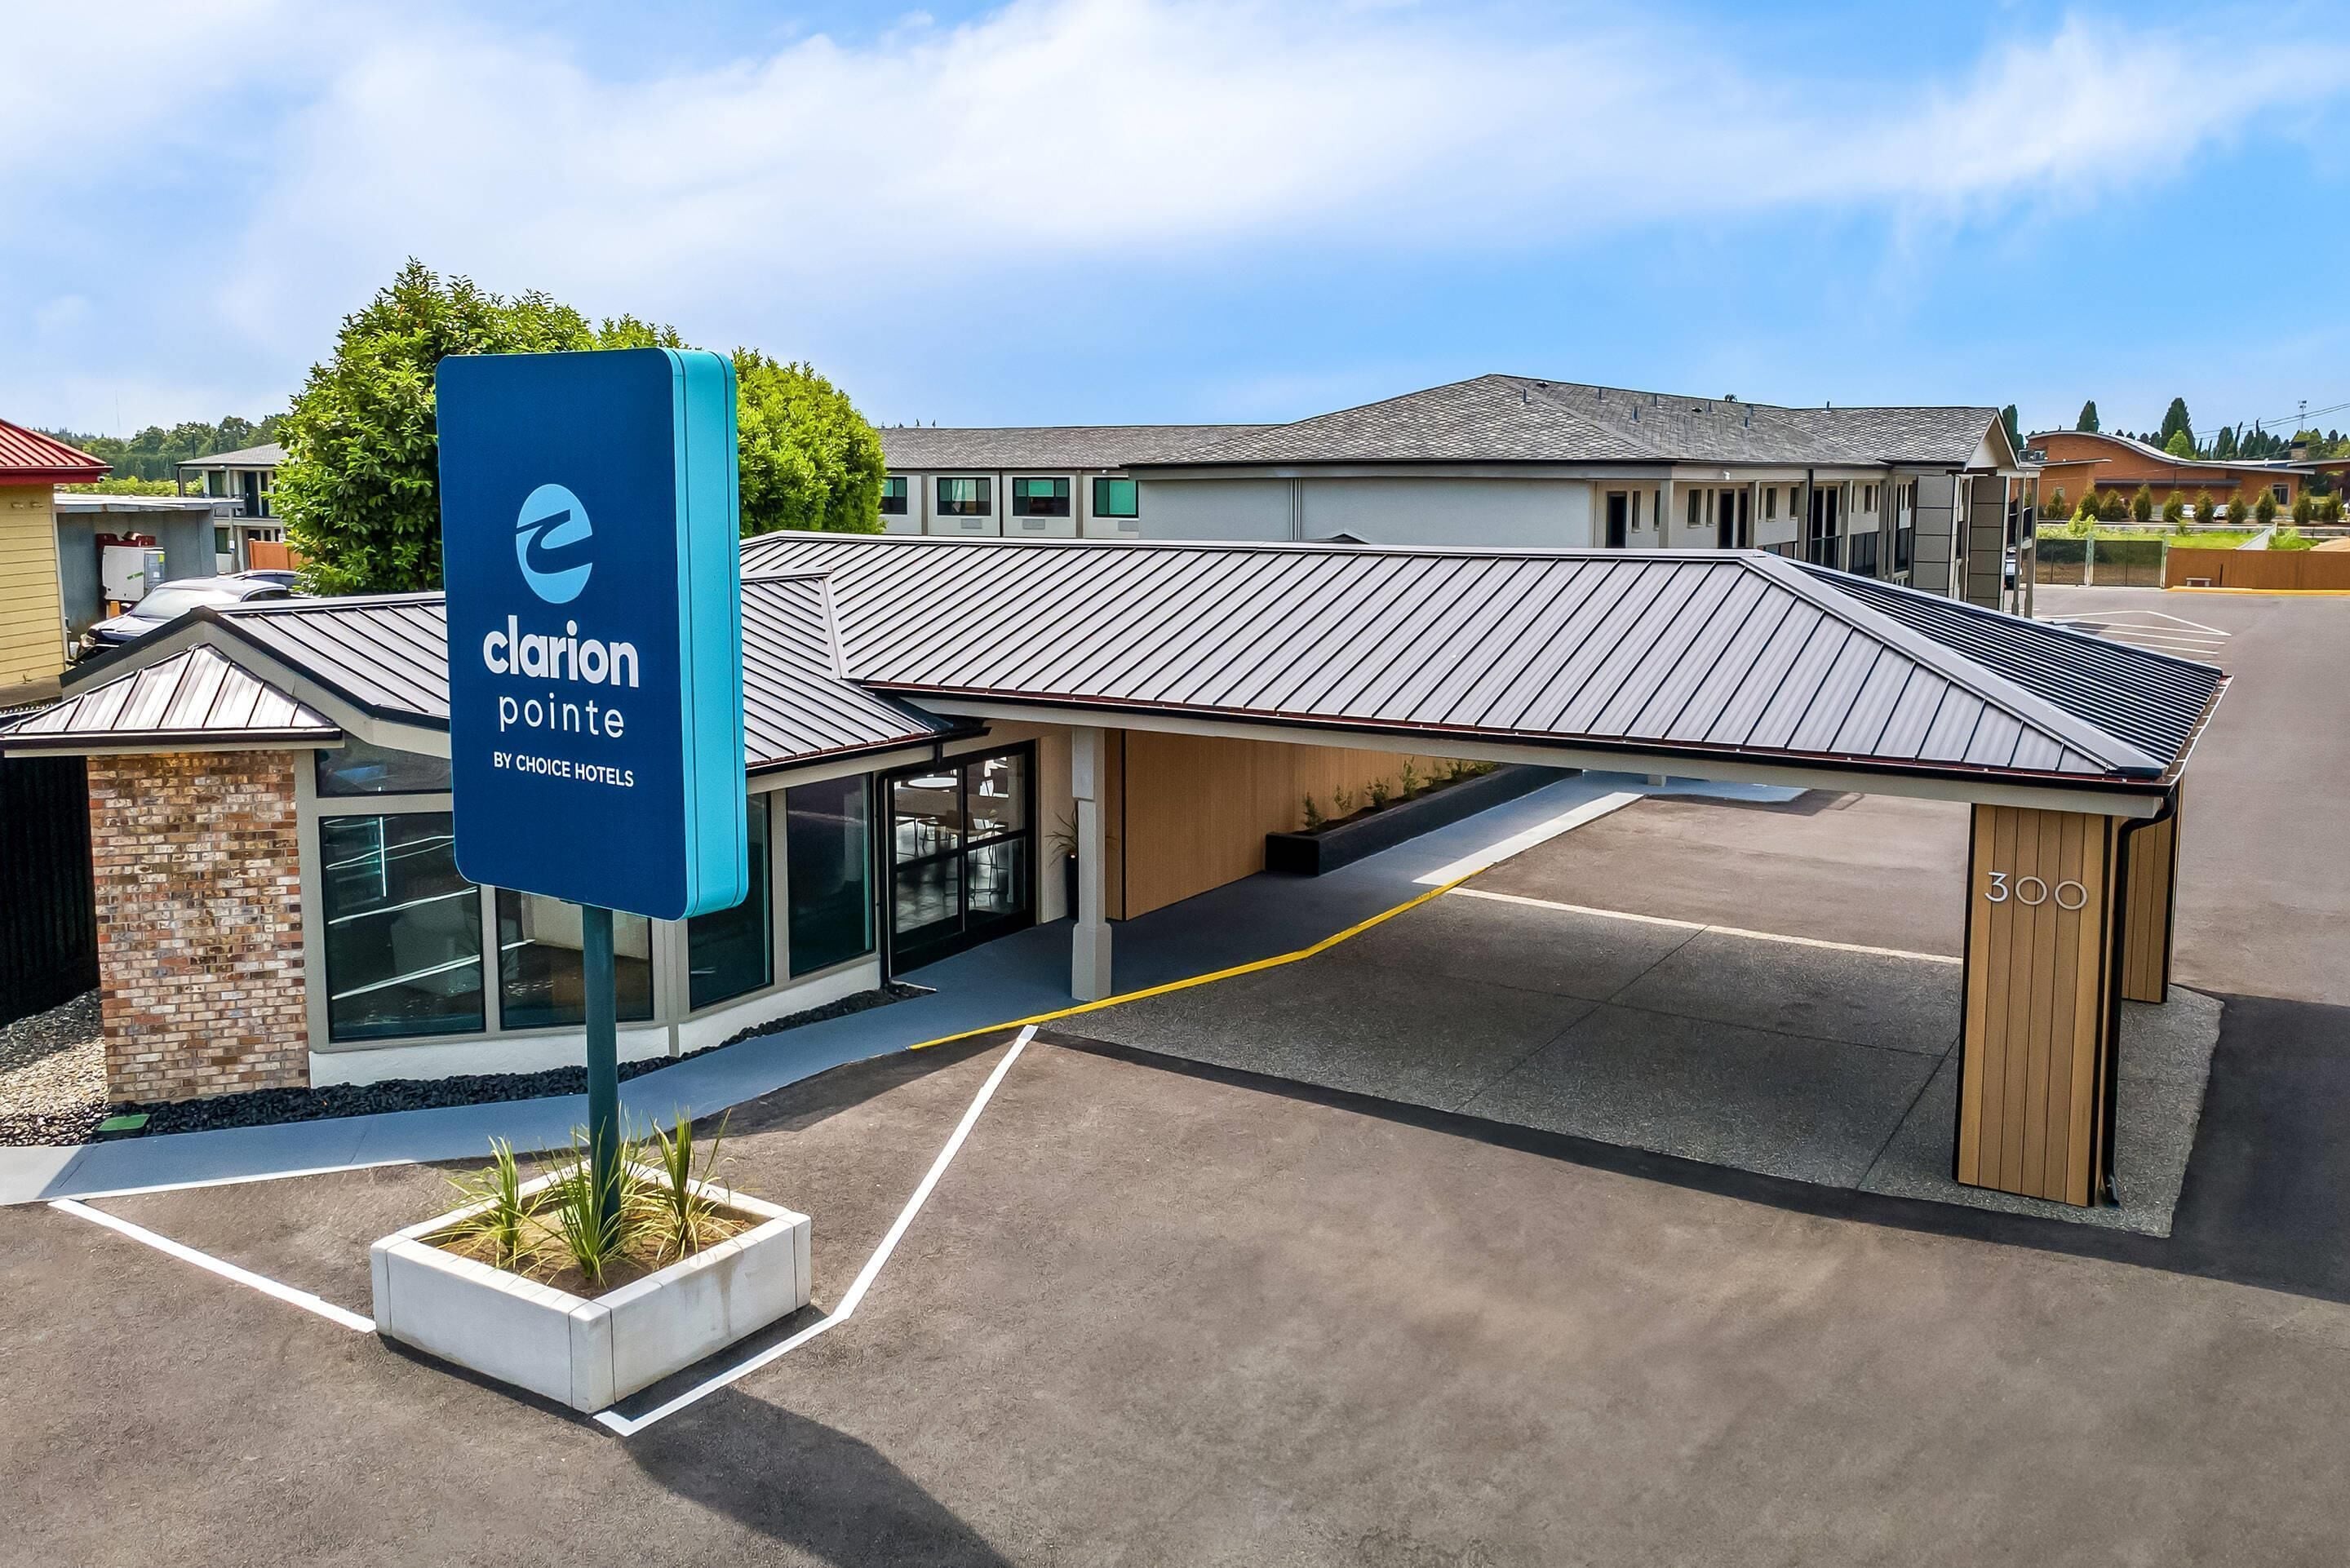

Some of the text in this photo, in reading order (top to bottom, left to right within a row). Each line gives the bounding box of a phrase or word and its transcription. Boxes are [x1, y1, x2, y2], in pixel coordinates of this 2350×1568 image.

[483, 614, 639, 688] clarion
[499, 692, 624, 738] pointe
[494, 751, 634, 787] BY CHOICE HOTELS
[1984, 871, 2088, 910] 300
